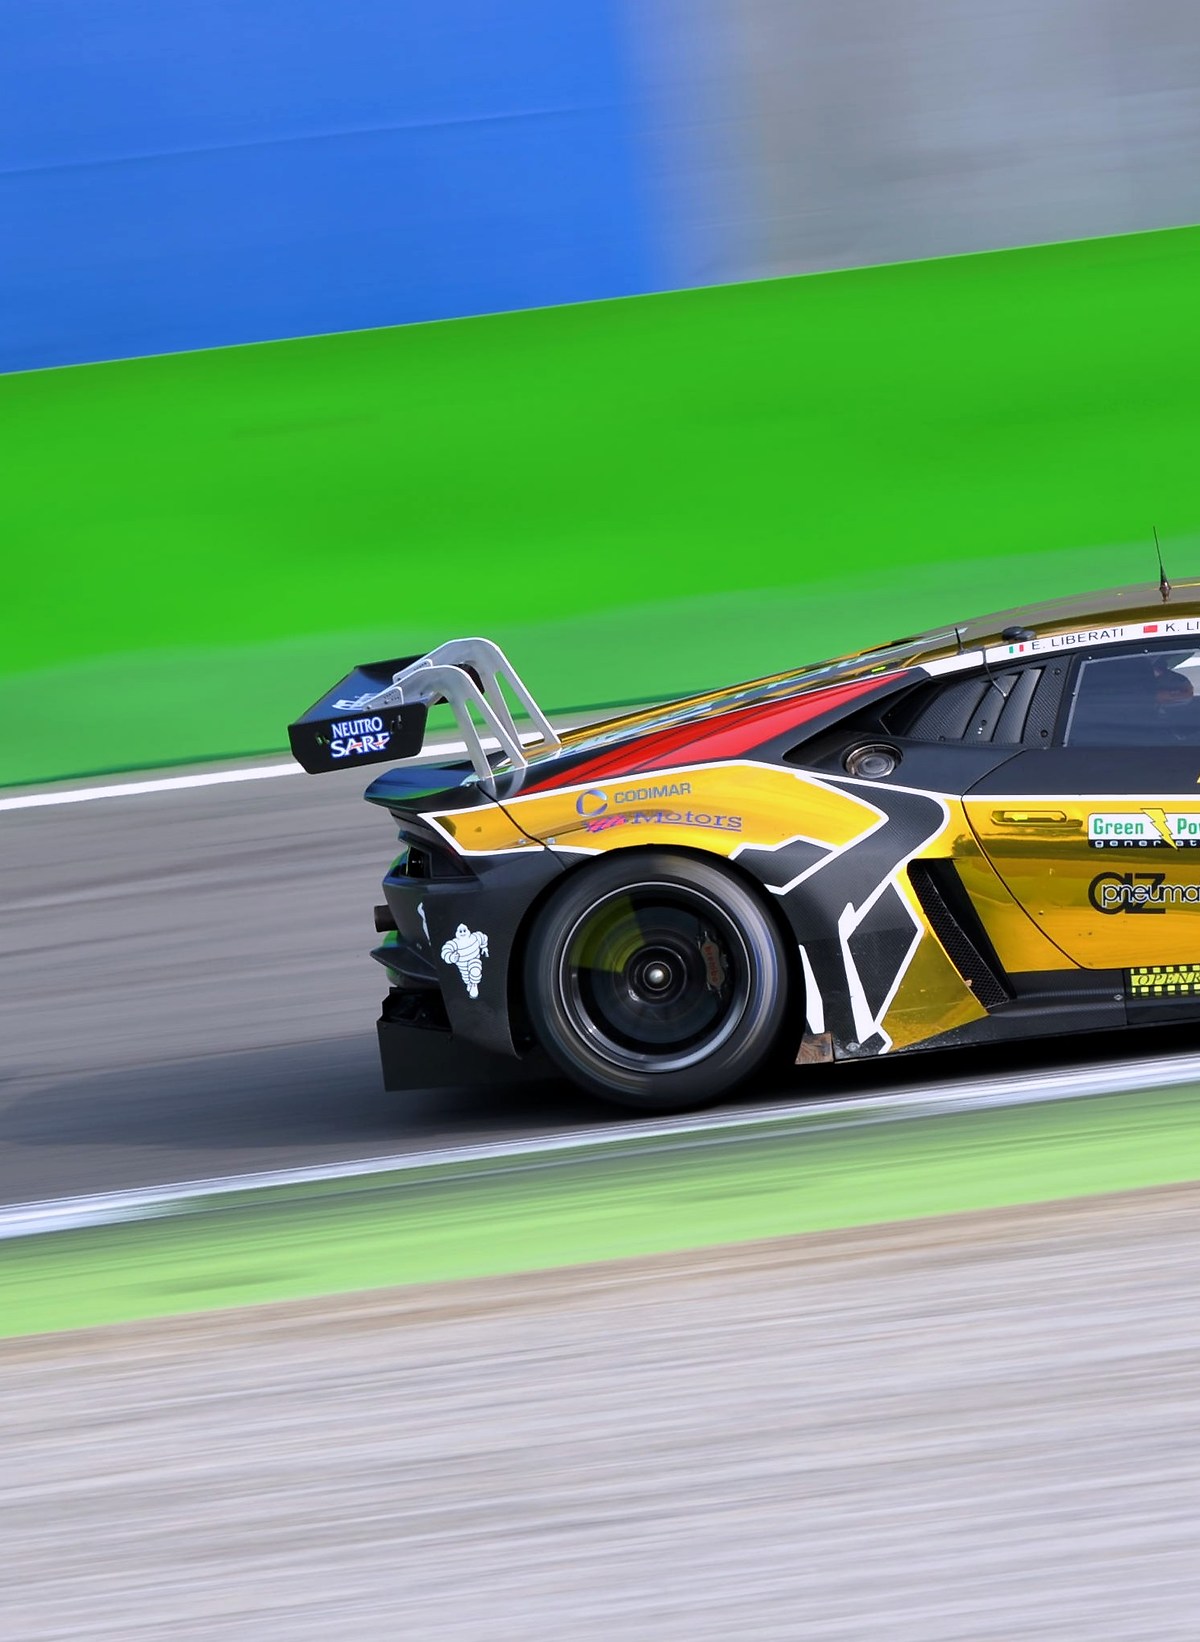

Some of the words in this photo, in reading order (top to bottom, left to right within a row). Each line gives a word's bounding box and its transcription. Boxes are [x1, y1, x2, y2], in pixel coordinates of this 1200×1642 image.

[1165, 622, 1180, 632] K.
[1031, 640, 1047, 651] E.
[1051, 628, 1125, 647] LIBERATI
[331, 716, 383, 739] NEUTRO
[631, 810, 742, 829] Motors
[1093, 818, 1144, 835] Green
